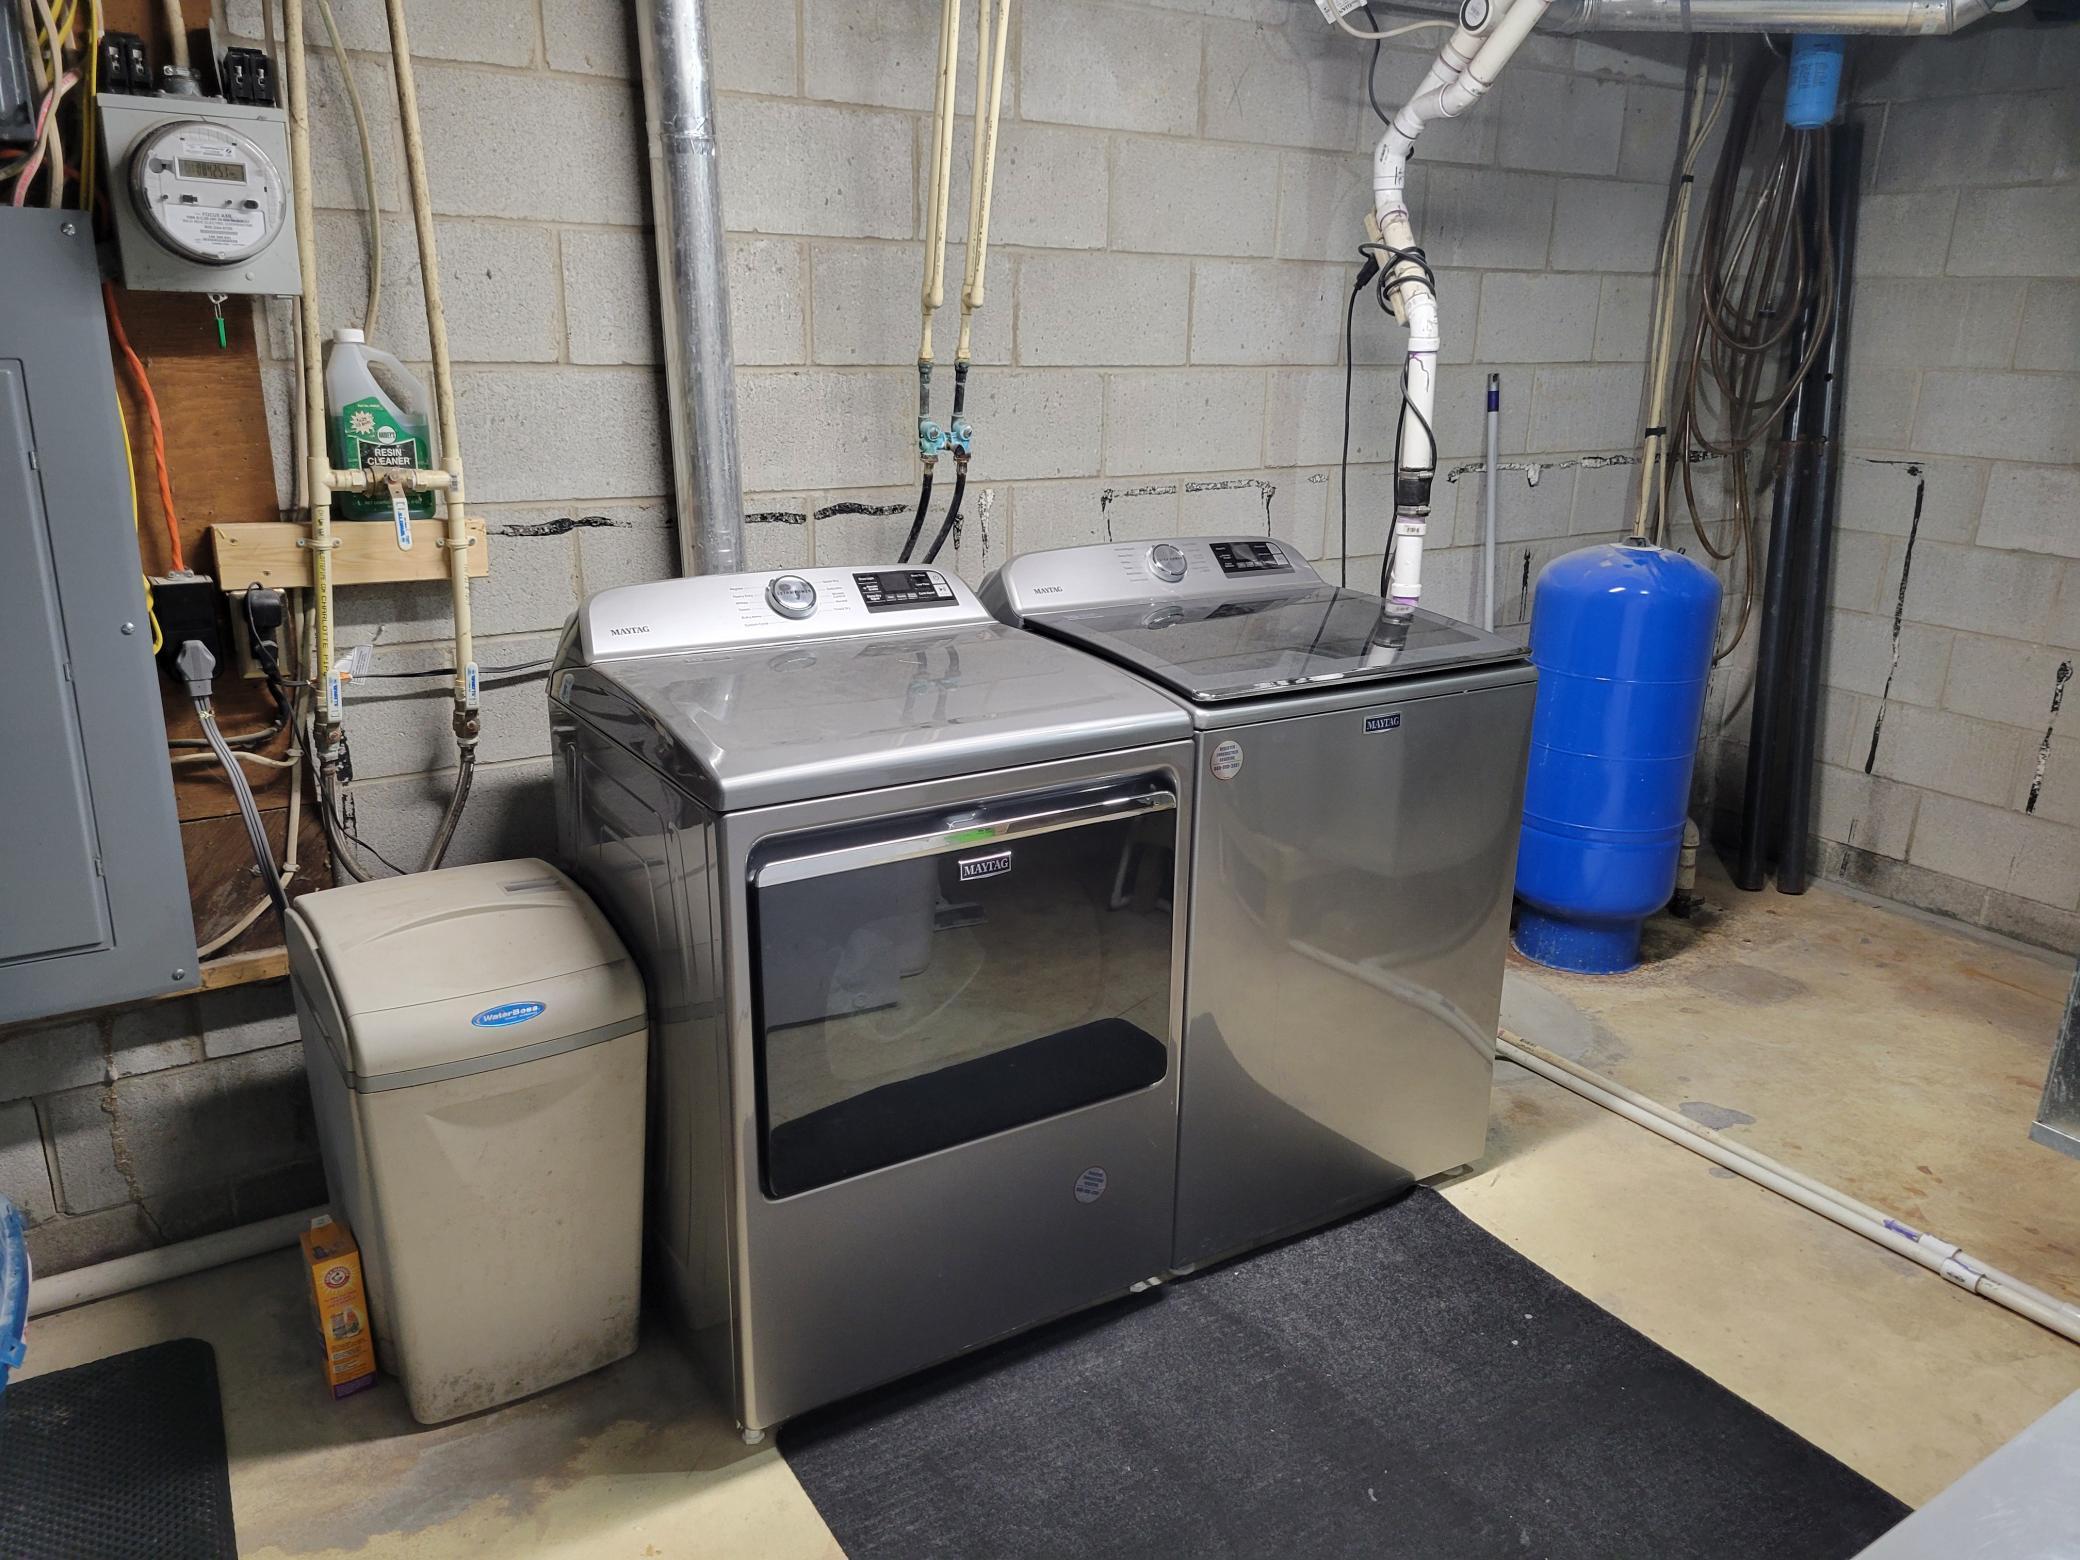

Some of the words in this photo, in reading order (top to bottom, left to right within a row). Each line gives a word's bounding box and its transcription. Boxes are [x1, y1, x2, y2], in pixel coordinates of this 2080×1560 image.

[374, 448, 402, 457] RESIN
[367, 456, 411, 466] CLEANER
[1033, 586, 1063, 594] MAYTAG
[321, 595, 329, 649] CHARLOTTE
[610, 625, 650, 636] MAYTAG
[1366, 716, 1400, 730] MAYTAG
[963, 858, 1009, 877] MAYTAG
